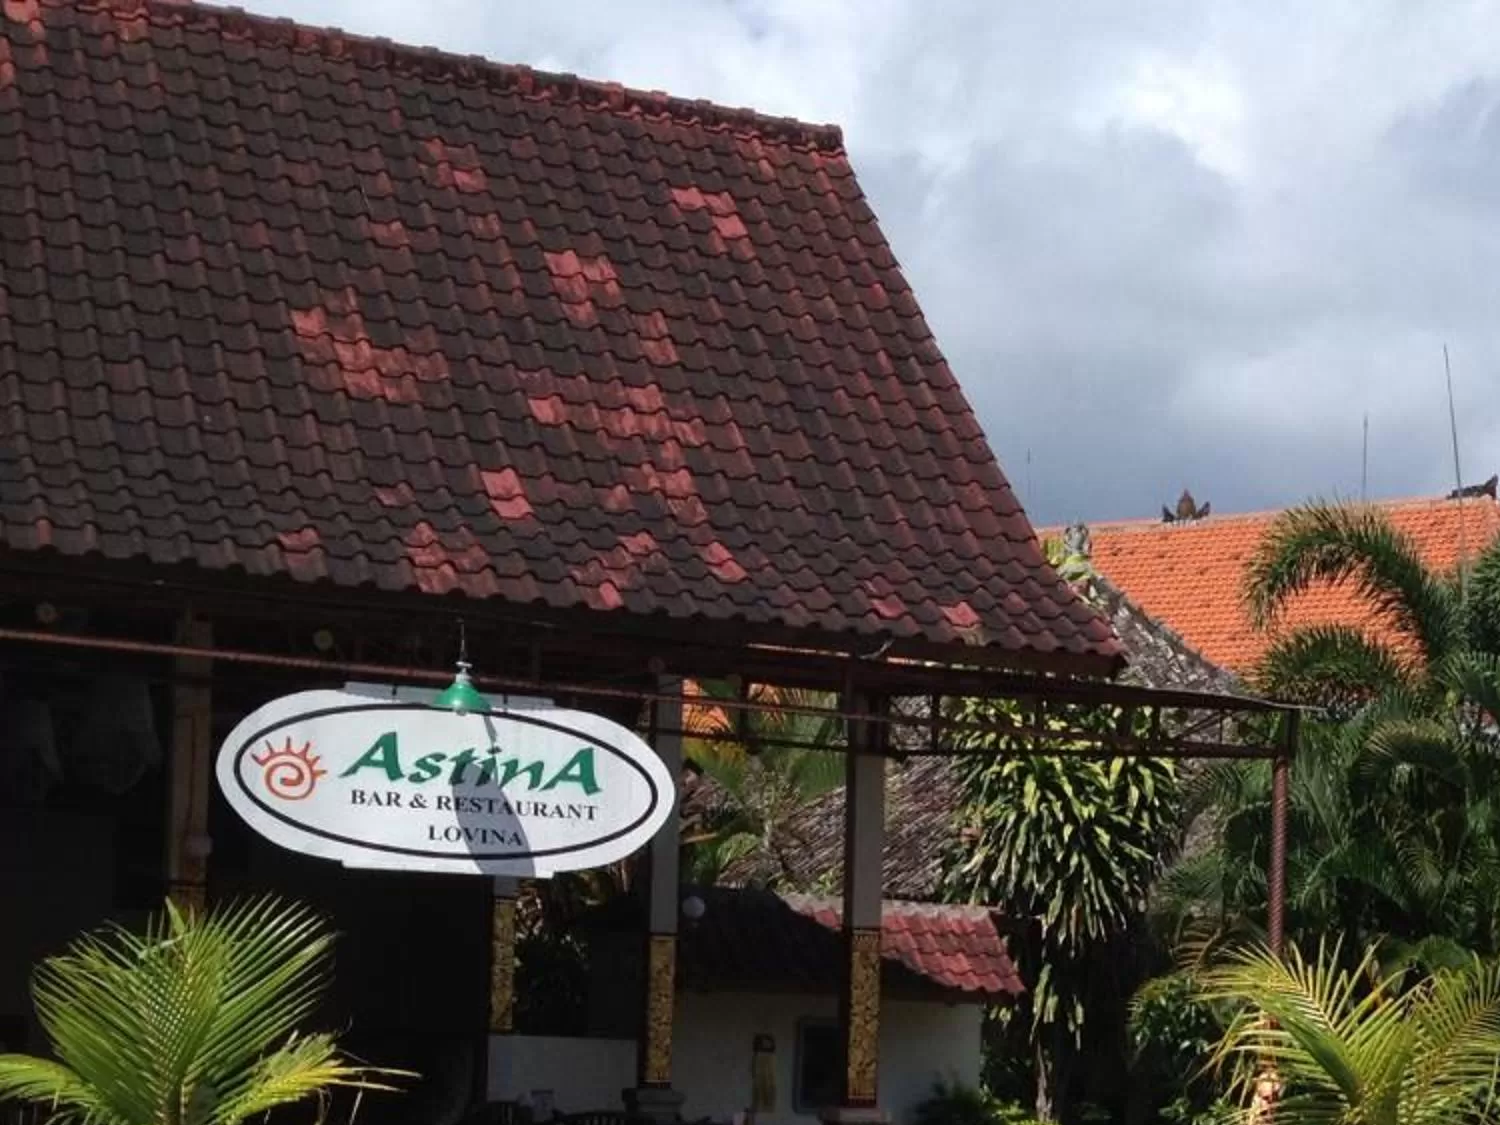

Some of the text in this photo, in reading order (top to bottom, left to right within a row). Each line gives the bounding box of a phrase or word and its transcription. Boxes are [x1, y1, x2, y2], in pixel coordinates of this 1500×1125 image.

[351, 789, 598, 821] BAR & RESTAURANT
[429, 824, 524, 847] LOVINA
